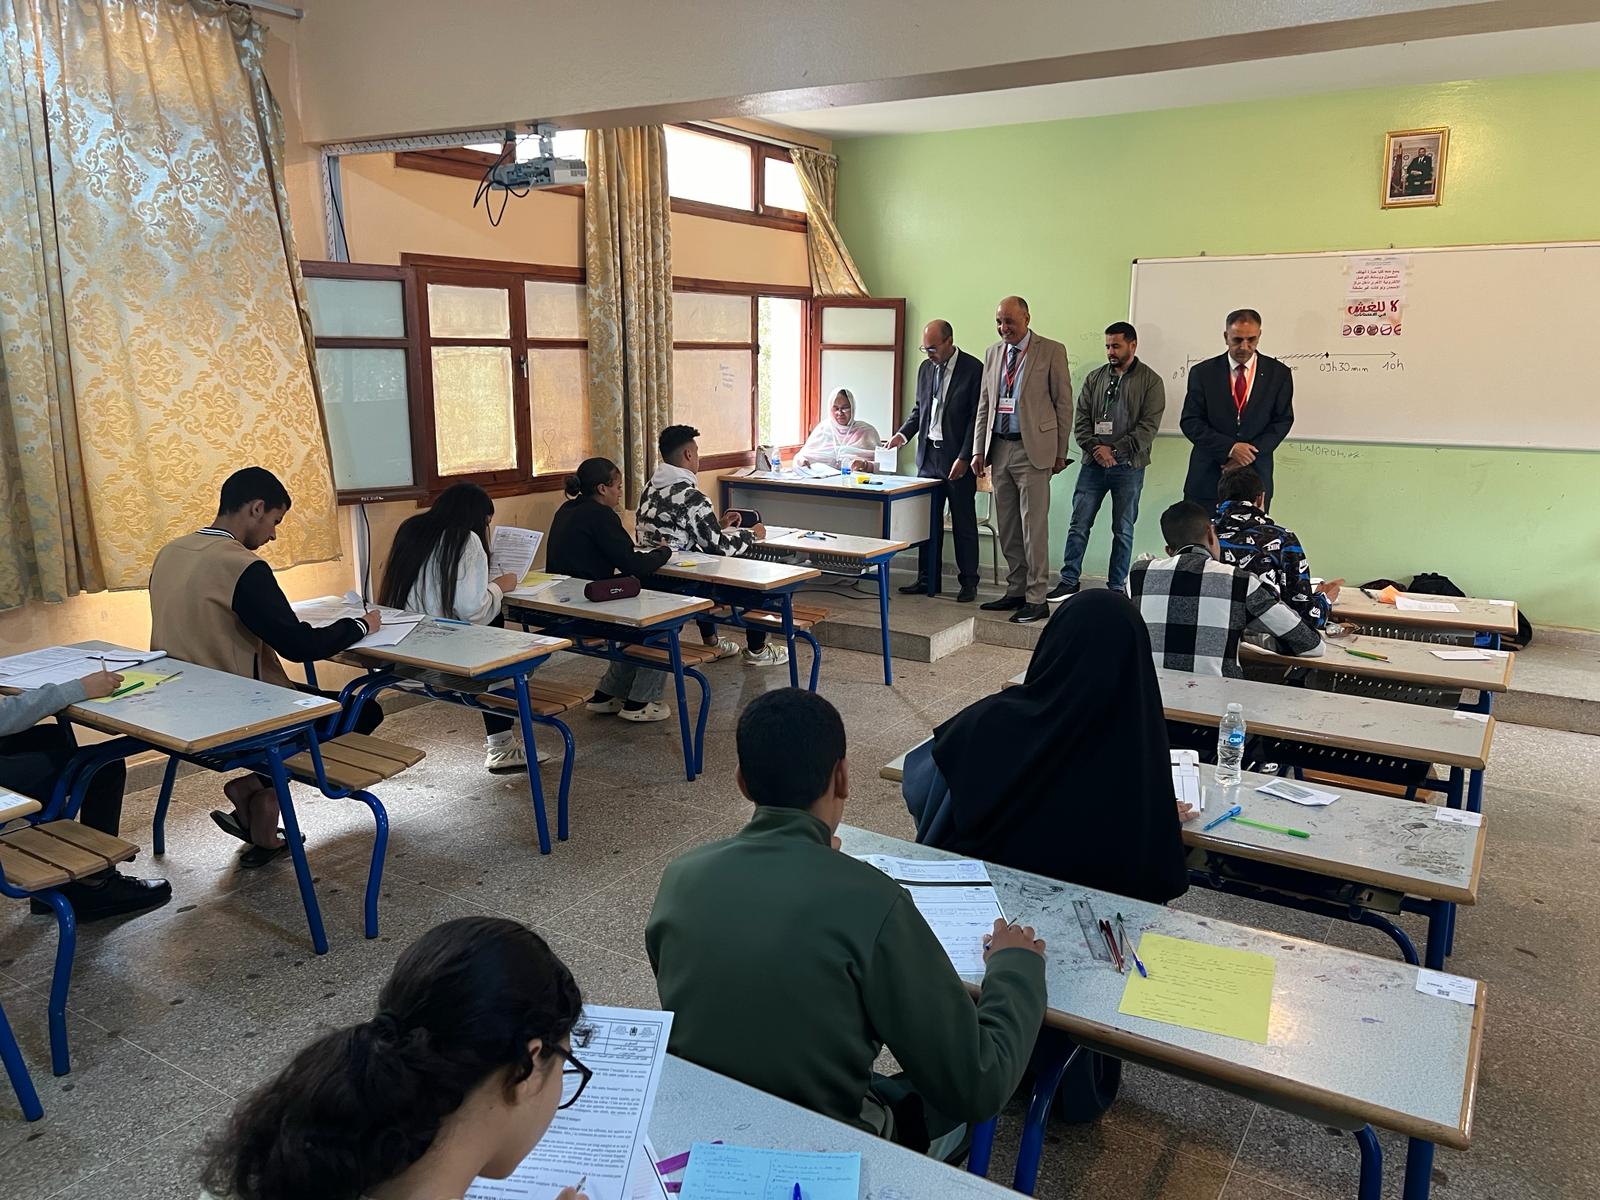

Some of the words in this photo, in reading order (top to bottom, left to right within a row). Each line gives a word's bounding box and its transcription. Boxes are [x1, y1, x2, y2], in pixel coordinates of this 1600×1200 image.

[1348, 301, 1385, 314] للغش
[1390, 299, 1400, 312] لا
[1382, 358, 1405, 371] 10h
